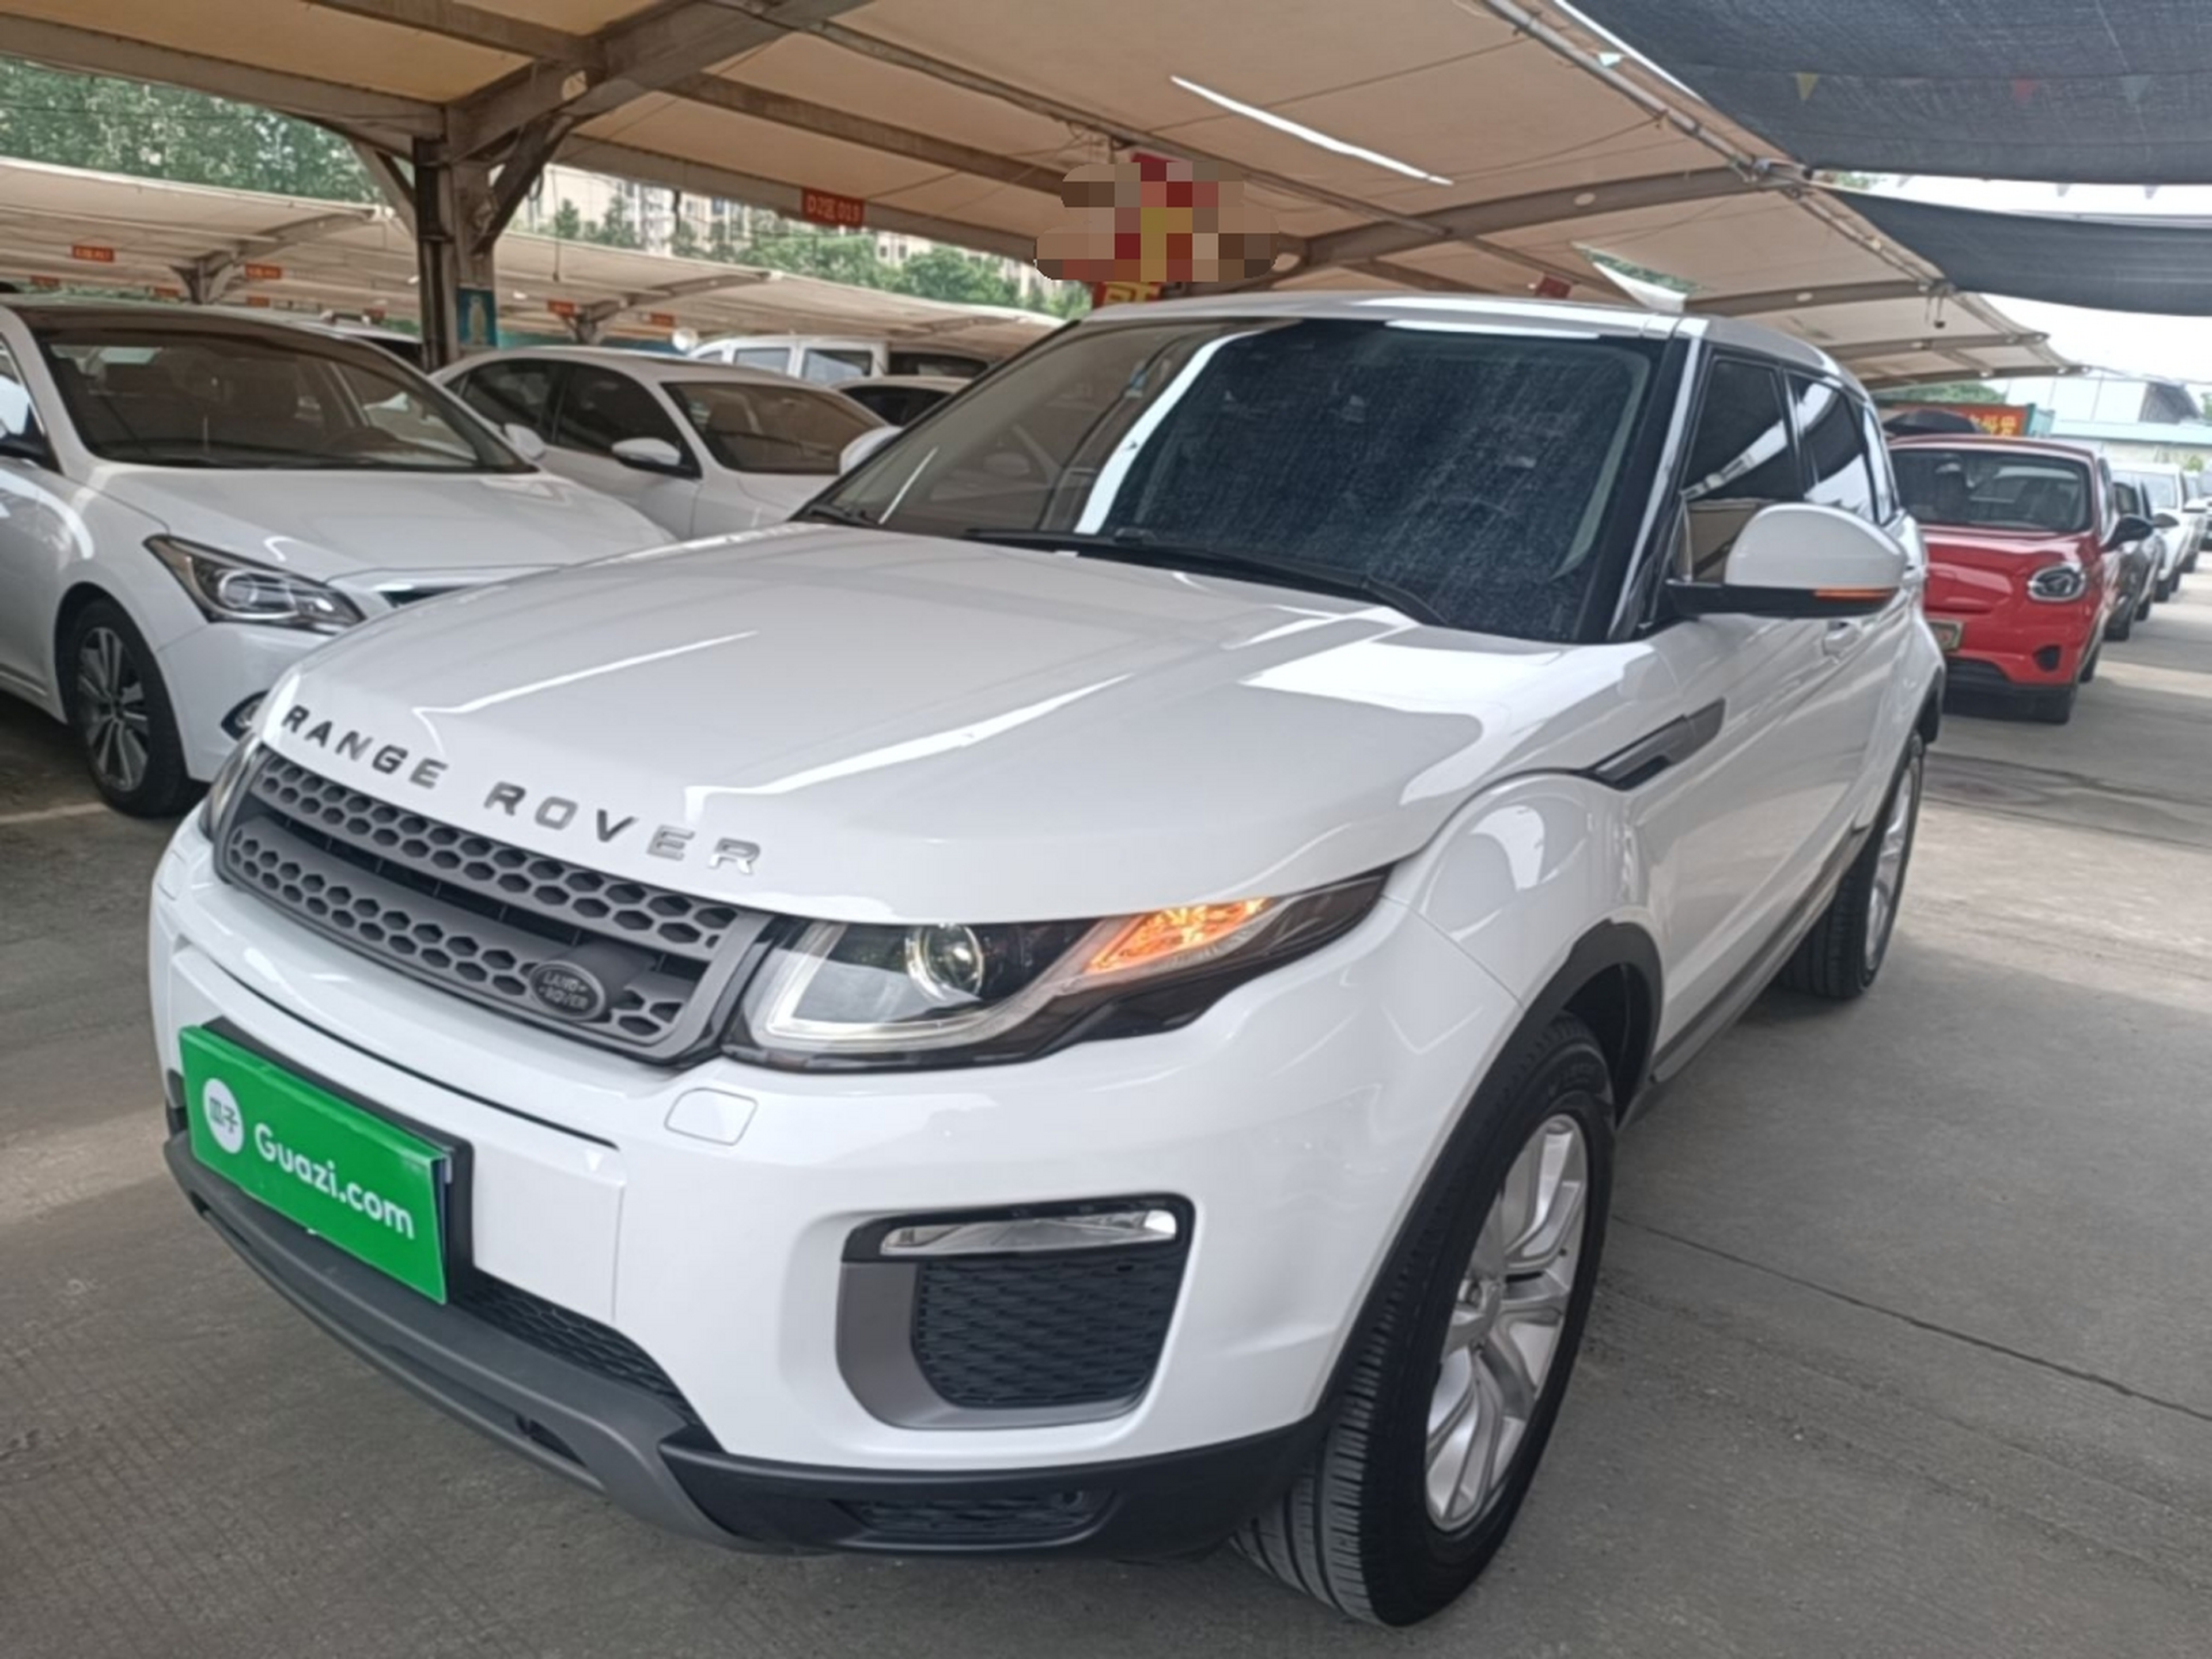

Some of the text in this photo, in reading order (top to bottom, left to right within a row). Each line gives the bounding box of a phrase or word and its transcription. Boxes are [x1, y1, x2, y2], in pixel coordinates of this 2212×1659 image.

[281, 704, 760, 874] RANGE ROVER
[255, 1122, 415, 1239] Guazi.com
